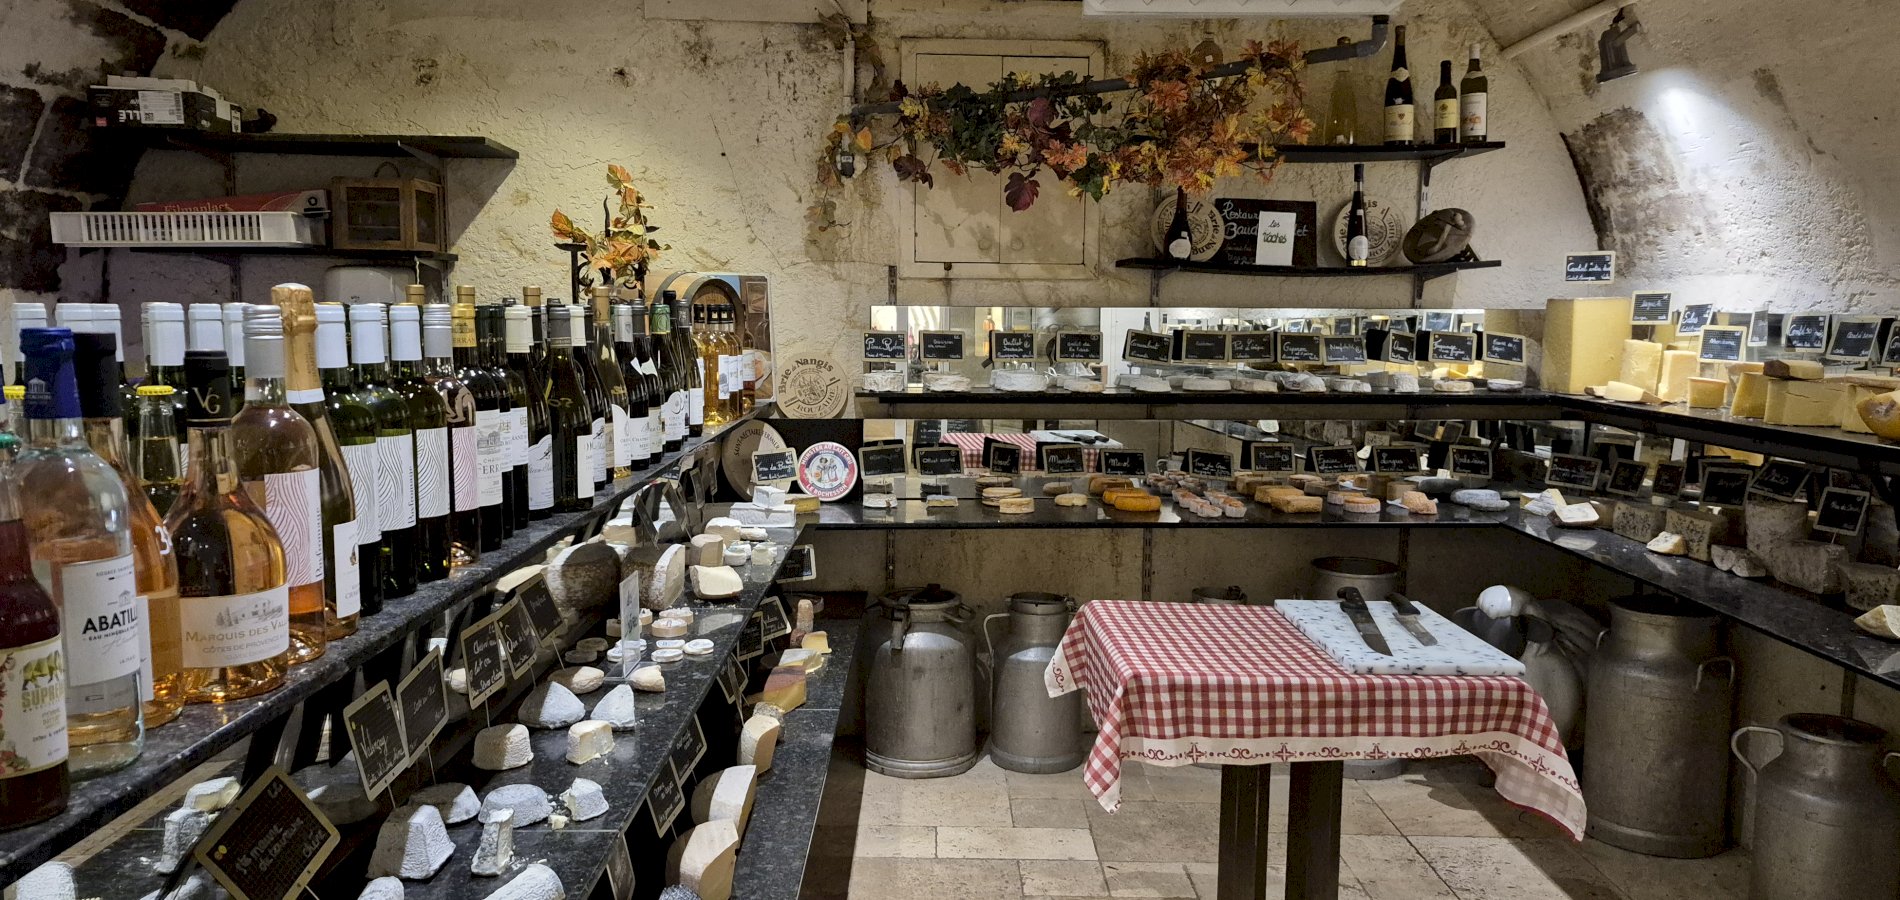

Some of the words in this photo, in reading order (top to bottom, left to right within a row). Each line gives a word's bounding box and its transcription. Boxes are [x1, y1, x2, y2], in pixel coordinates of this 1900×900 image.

[1220, 199, 1260, 221] Restaur
[795, 358, 834, 373] Nangis
[82, 607, 138, 635] ABATILL
[185, 630, 245, 642] MARQUIS
[249, 626, 269, 637] DES
